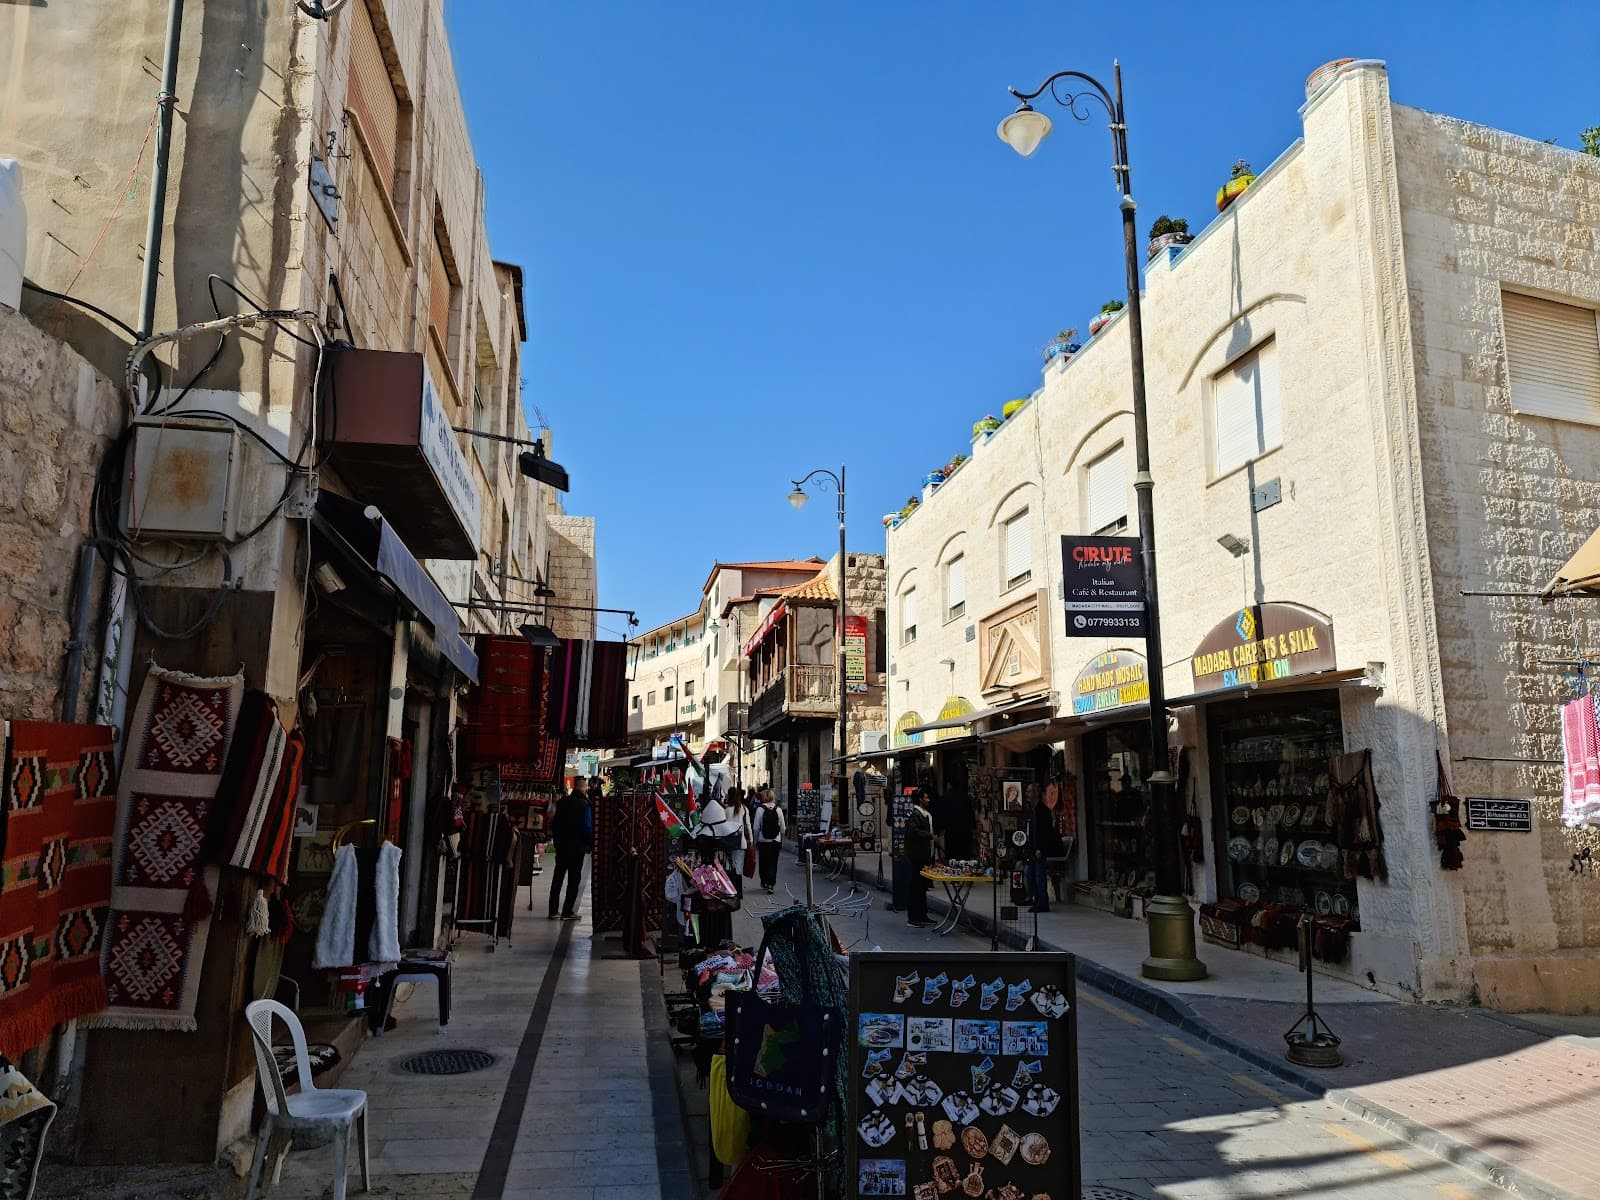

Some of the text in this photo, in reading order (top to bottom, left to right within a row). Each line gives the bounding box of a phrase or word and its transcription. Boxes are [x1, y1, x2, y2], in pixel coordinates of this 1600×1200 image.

[1072, 546, 1133, 563] CIRUTE
[1092, 578, 1115, 586] Italian
[1072, 588, 1089, 596] Café
[1098, 588, 1138, 597] Restaurant
[1087, 618, 1140, 627] 0779933133
[1194, 626, 1319, 677] MADABA CARPETS & SILK
[747, 1076, 802, 1097] JORDAN
